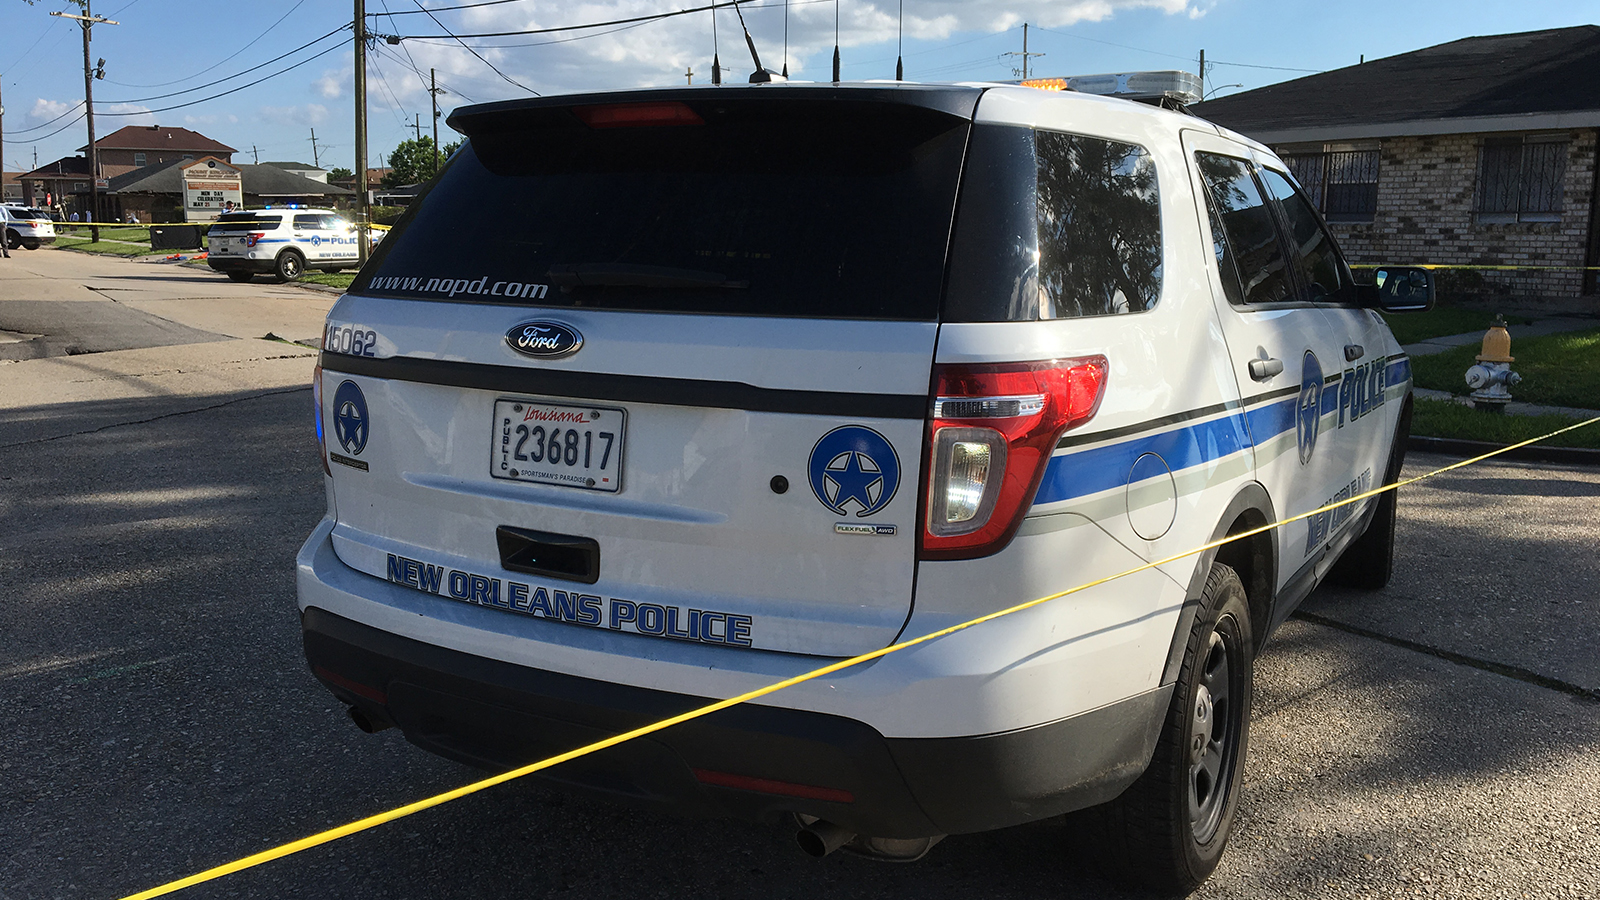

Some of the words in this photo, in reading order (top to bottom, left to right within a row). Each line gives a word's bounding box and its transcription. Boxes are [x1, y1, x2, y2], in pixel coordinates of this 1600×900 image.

[369, 276, 548, 299] www.nopd.com
[518, 325, 561, 349] Ford
[1337, 355, 1386, 430] POLICE
[523, 406, 590, 424] Louisiana
[501, 418, 510, 471] PUBLIC
[514, 424, 615, 470] 236817
[520, 469, 558, 480] SPORTSMAN'S
[559, 474, 587, 484] PARADISE
[387, 553, 444, 594] NEW
[448, 569, 602, 626] ORLEANS
[609, 598, 753, 647] POLICE
